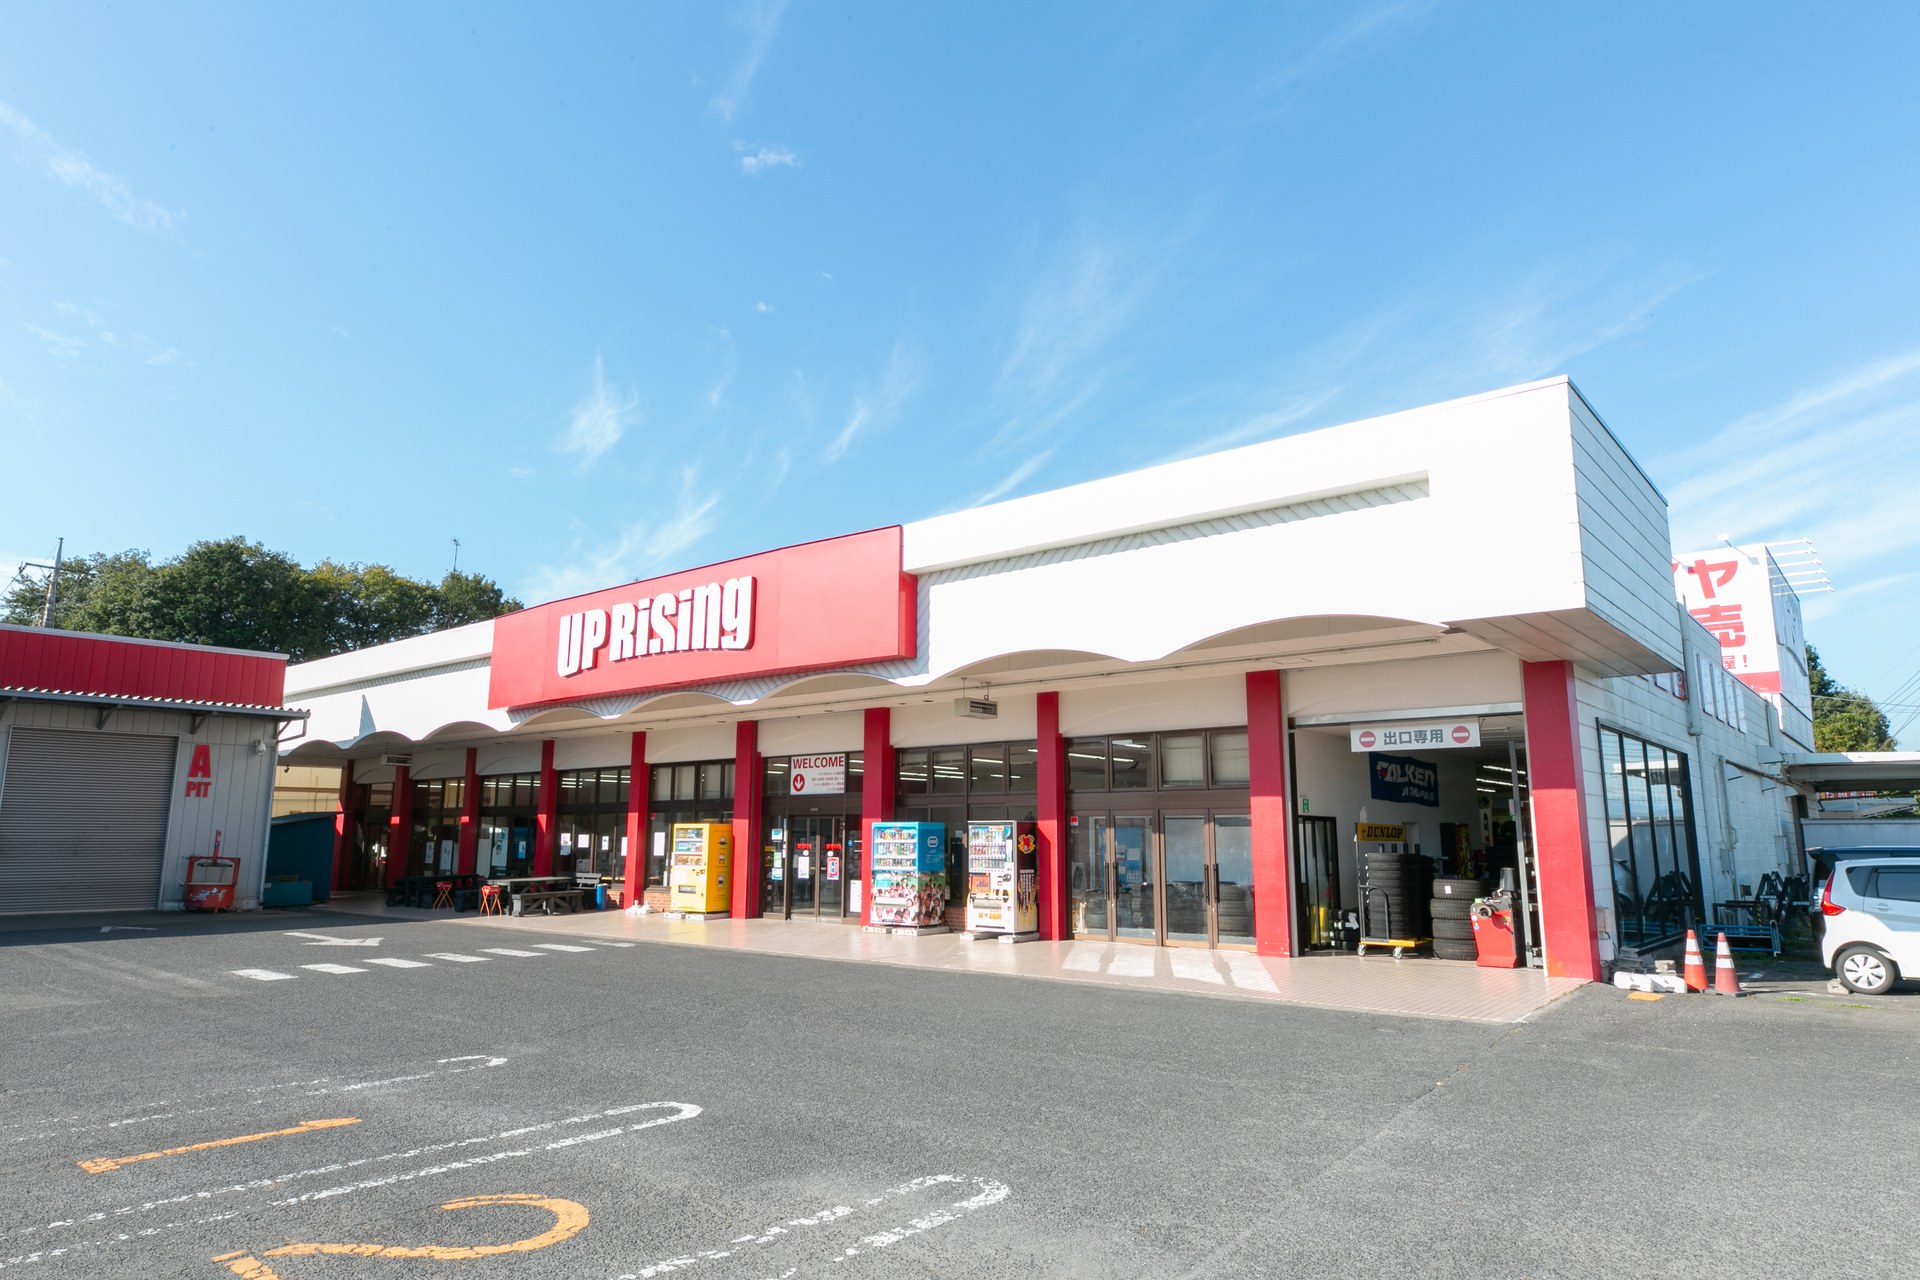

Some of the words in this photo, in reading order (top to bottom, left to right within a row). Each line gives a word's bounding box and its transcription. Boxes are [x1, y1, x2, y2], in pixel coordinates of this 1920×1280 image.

[1384, 729, 1443, 746] 出口専用
[188, 744, 211, 778] A
[793, 756, 844, 769] WELCOME
[1376, 761, 1436, 788] FALKEN
[185, 782, 211, 798] PIT
[1366, 826, 1403, 839] DUNLOP
